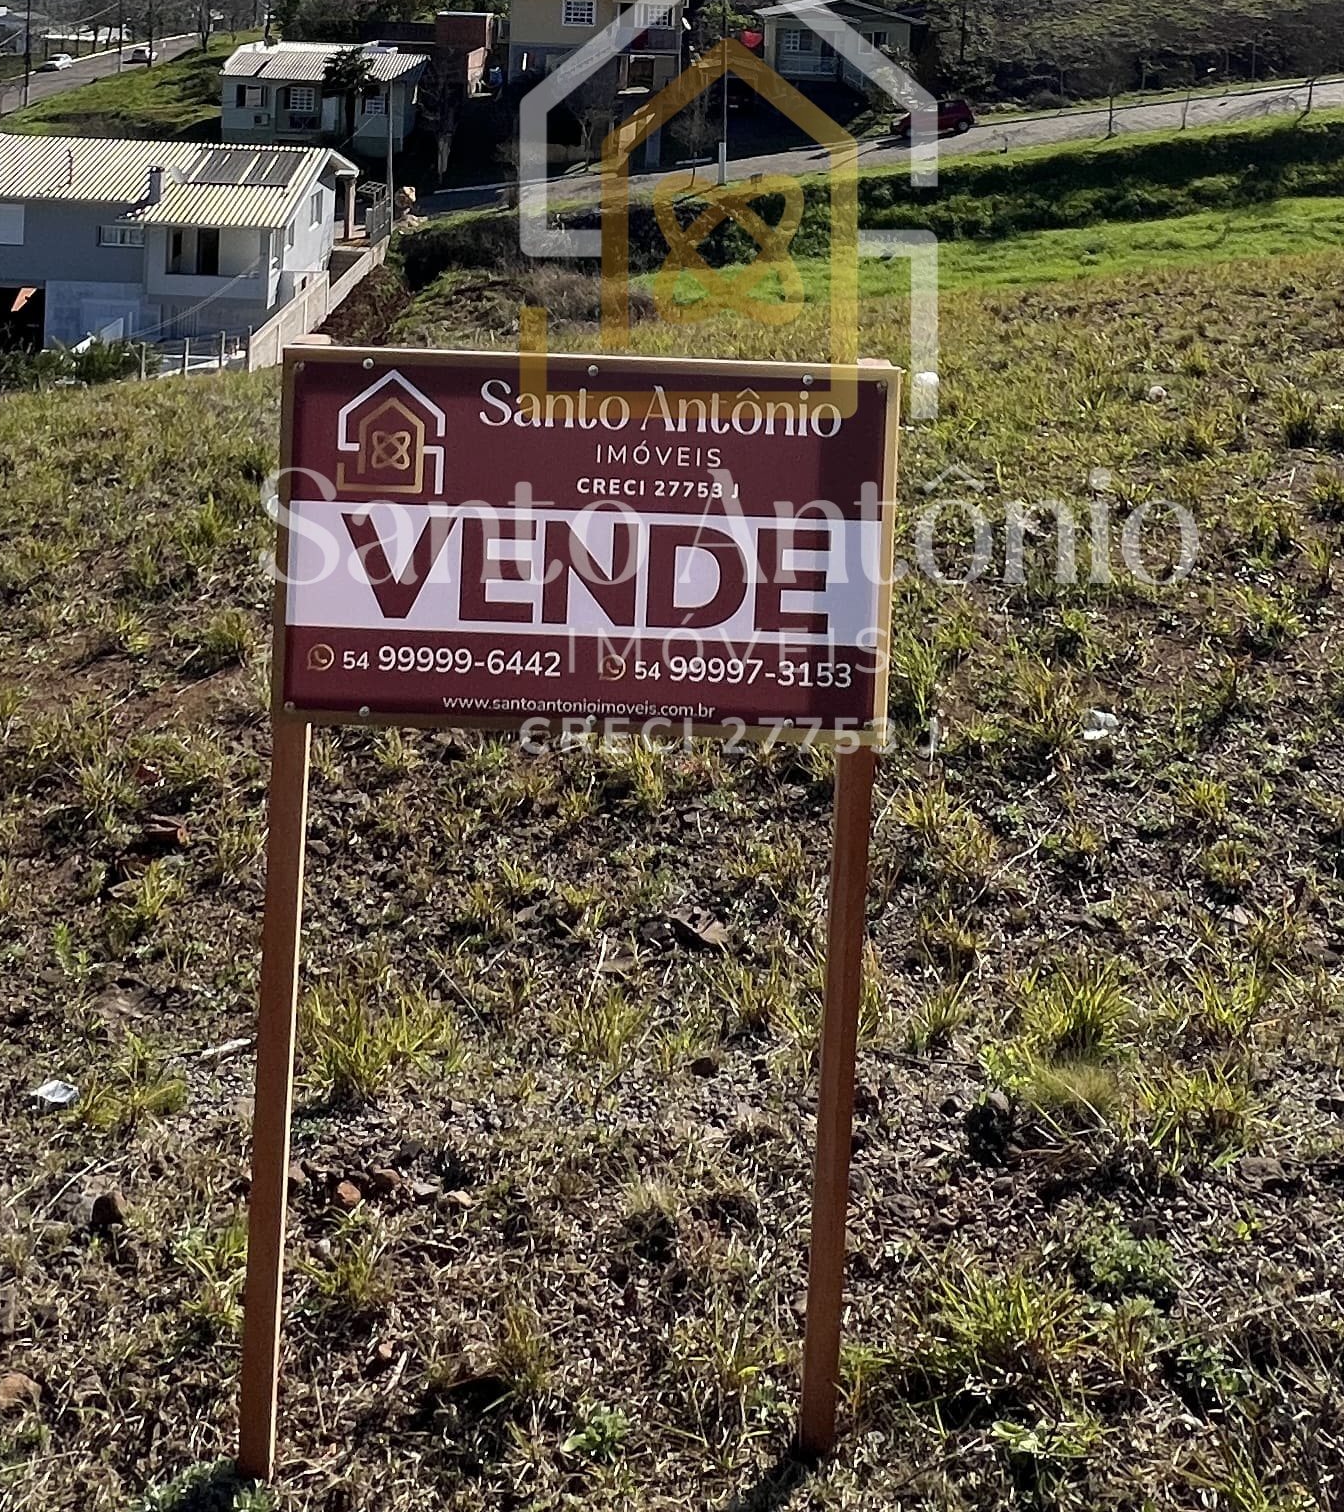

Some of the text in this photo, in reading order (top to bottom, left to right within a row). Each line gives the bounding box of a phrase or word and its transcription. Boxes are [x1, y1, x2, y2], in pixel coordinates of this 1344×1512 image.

[478, 378, 843, 438] Santo Antônio
[595, 439, 722, 468] IMÓVEIS
[576, 476, 740, 500] CRECI 27753 J
[340, 511, 832, 635] VENDE
[342, 645, 562, 678] 54 99999-6442
[634, 655, 852, 689] 54 99997-3153
[442, 695, 716, 719] www.santoantonioimoveis.com.br
